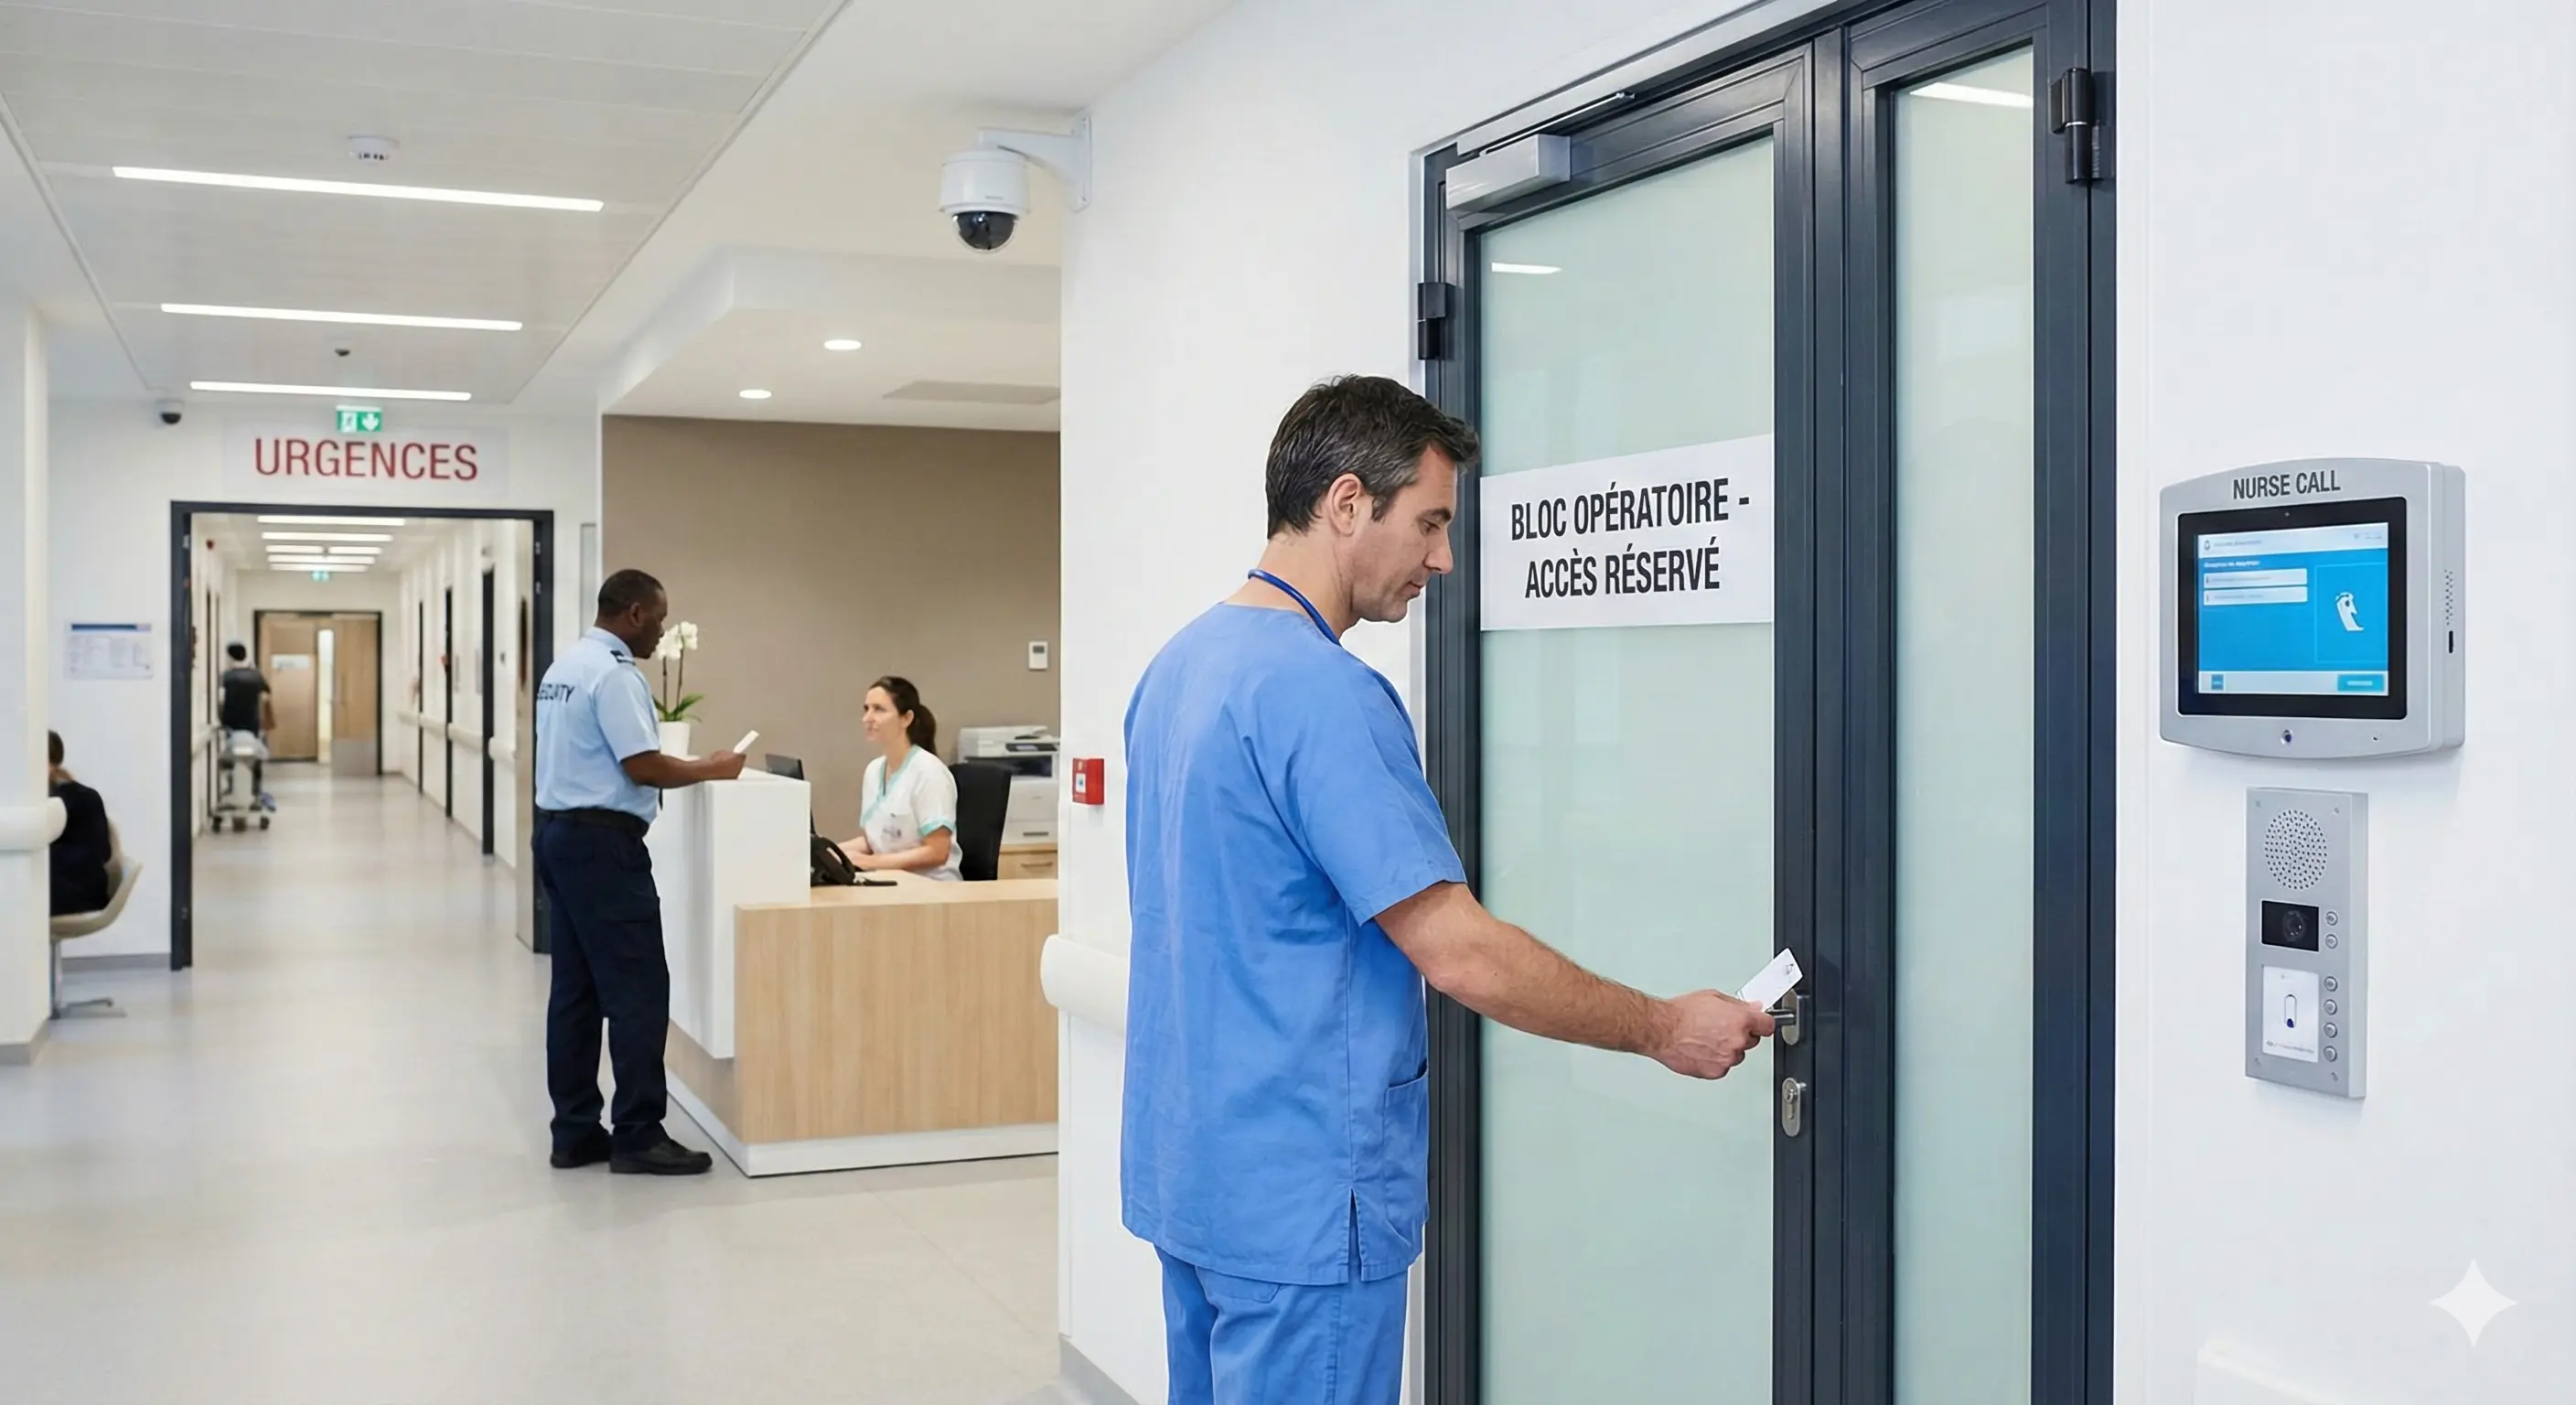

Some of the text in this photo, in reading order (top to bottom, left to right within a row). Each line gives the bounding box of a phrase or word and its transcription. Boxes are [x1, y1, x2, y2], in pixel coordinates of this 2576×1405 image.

[254, 438, 478, 481] URGENCES
[2233, 469, 2342, 499] NURSE CALL
[1511, 477, 1750, 542] BLOC OPÉRATOIRE -
[1525, 536, 1720, 598] ACCÈS RÉSERVÉ
